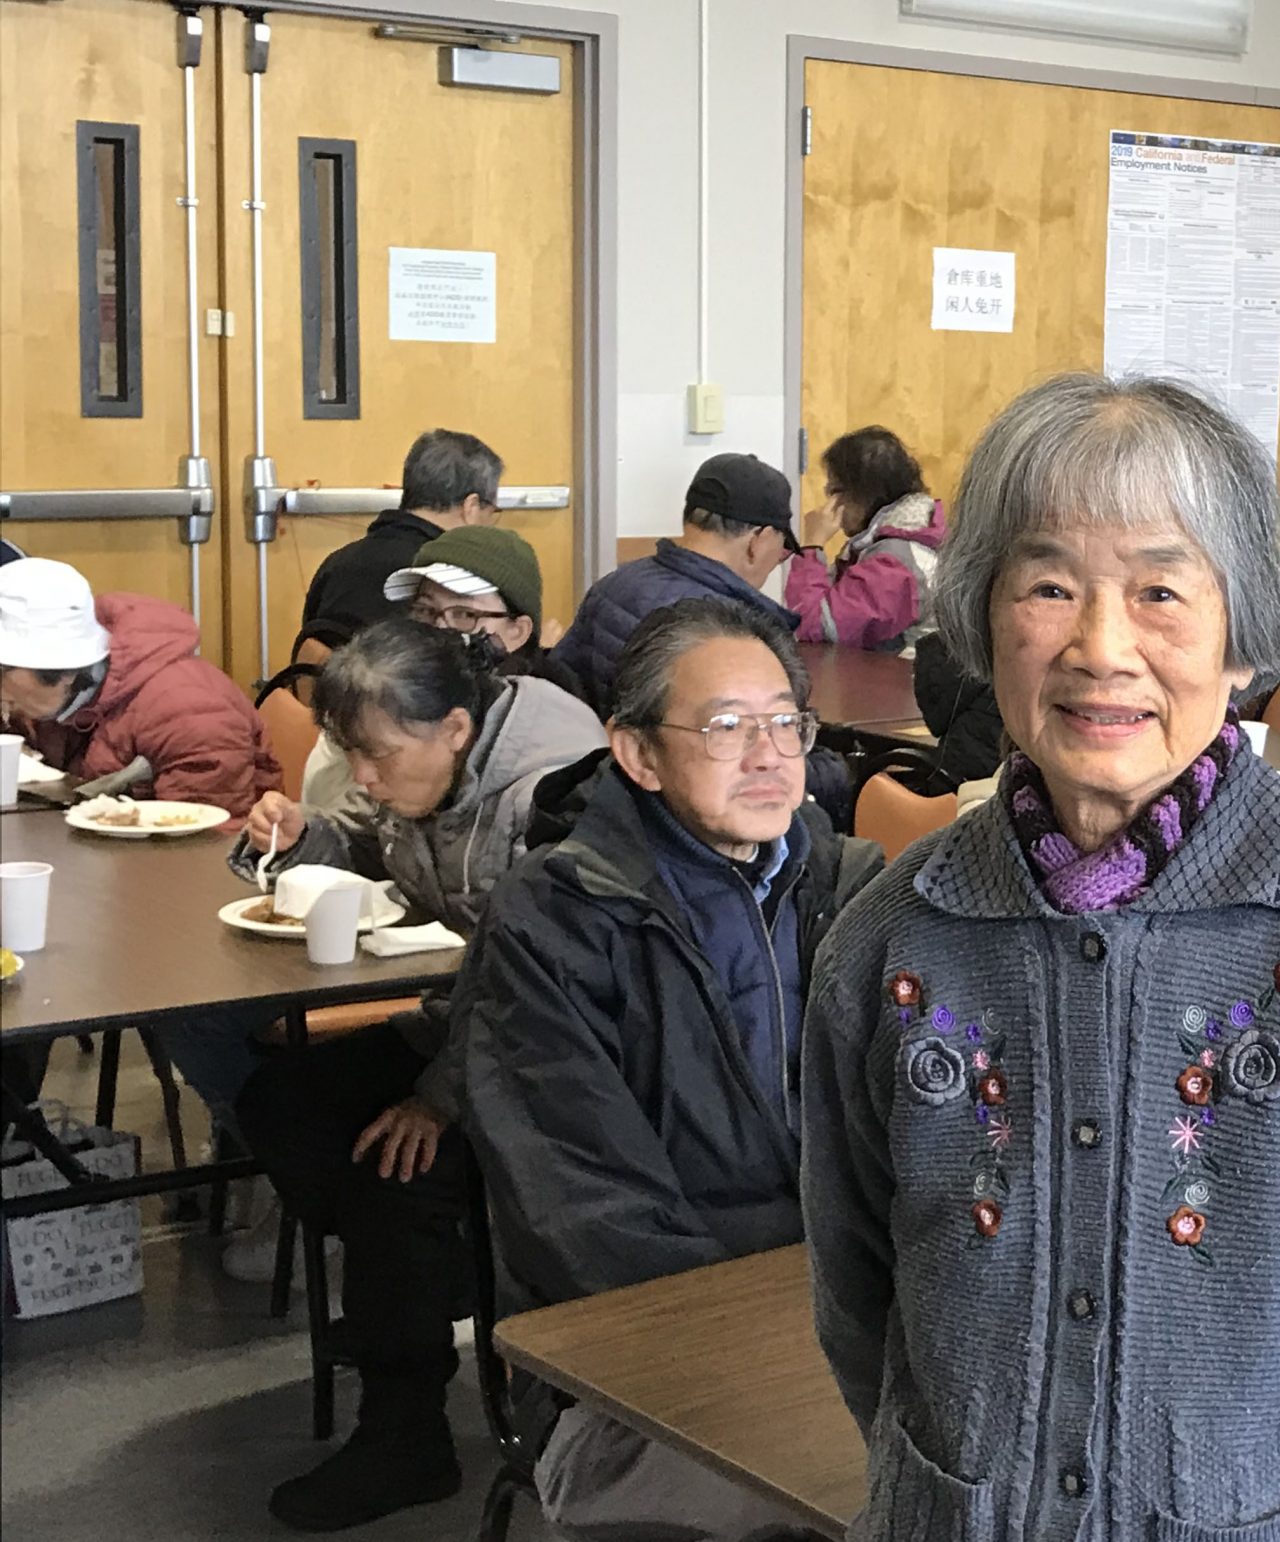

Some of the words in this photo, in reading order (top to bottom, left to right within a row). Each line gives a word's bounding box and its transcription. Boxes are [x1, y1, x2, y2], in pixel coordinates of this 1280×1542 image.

[1111, 145, 1133, 157] 2019
[1135, 147, 1183, 162] California
[1201, 152, 1236, 165] Federal
[1111, 157, 1171, 171] Employment
[1174, 162, 1208, 174] Notices
